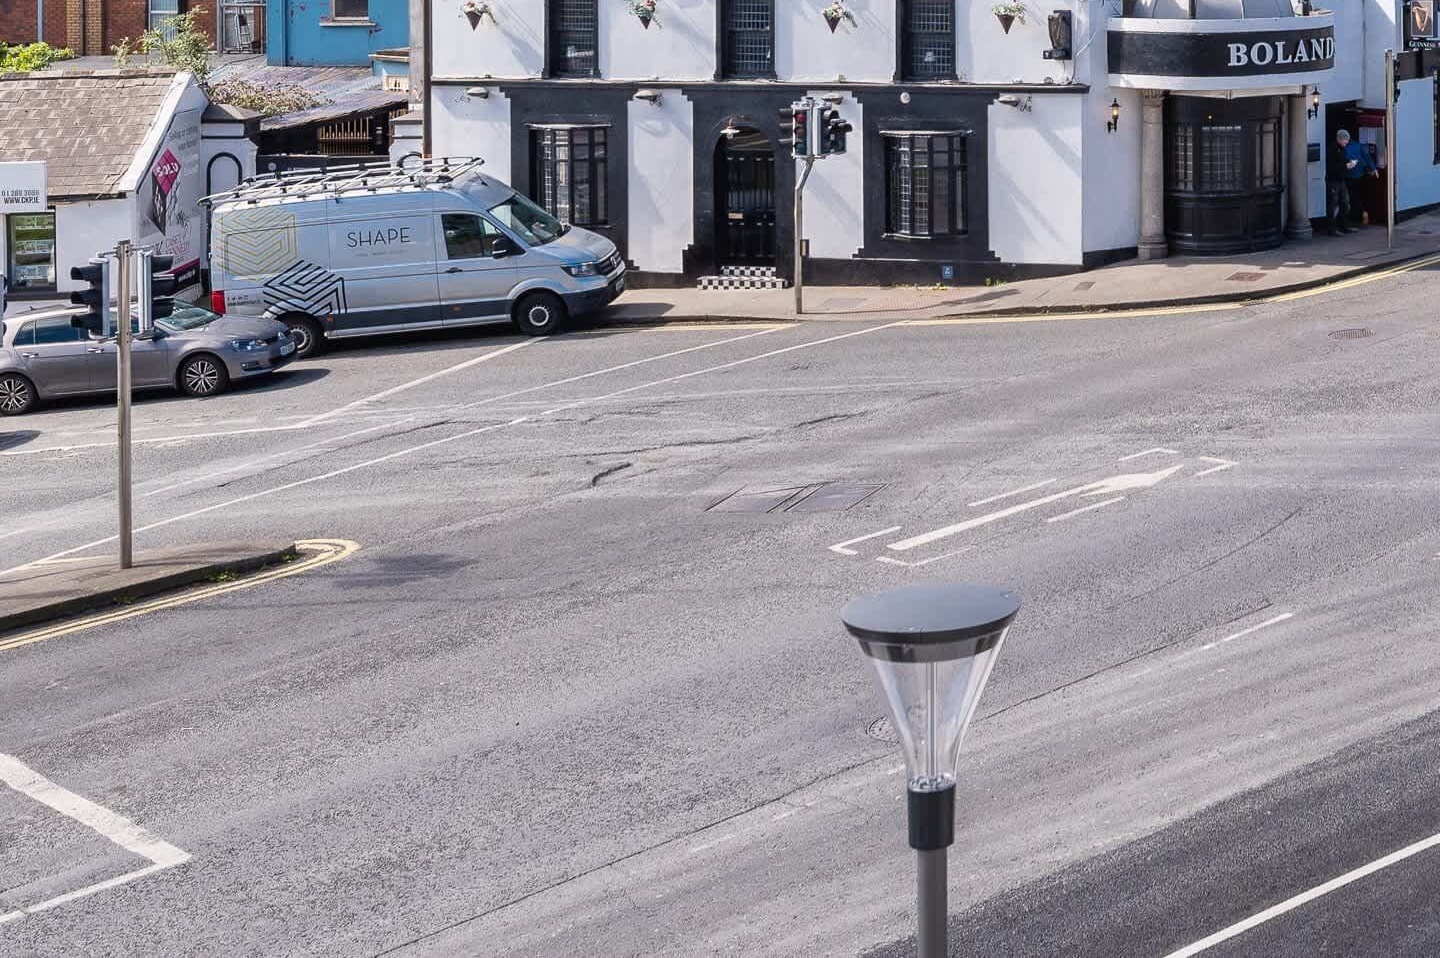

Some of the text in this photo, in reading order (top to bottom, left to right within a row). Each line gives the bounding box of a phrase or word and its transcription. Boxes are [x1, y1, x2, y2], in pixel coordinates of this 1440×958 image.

[1227, 37, 1336, 66] BOLAND
[154, 162, 179, 177] SOLD
[347, 226, 411, 248] SHAPE
